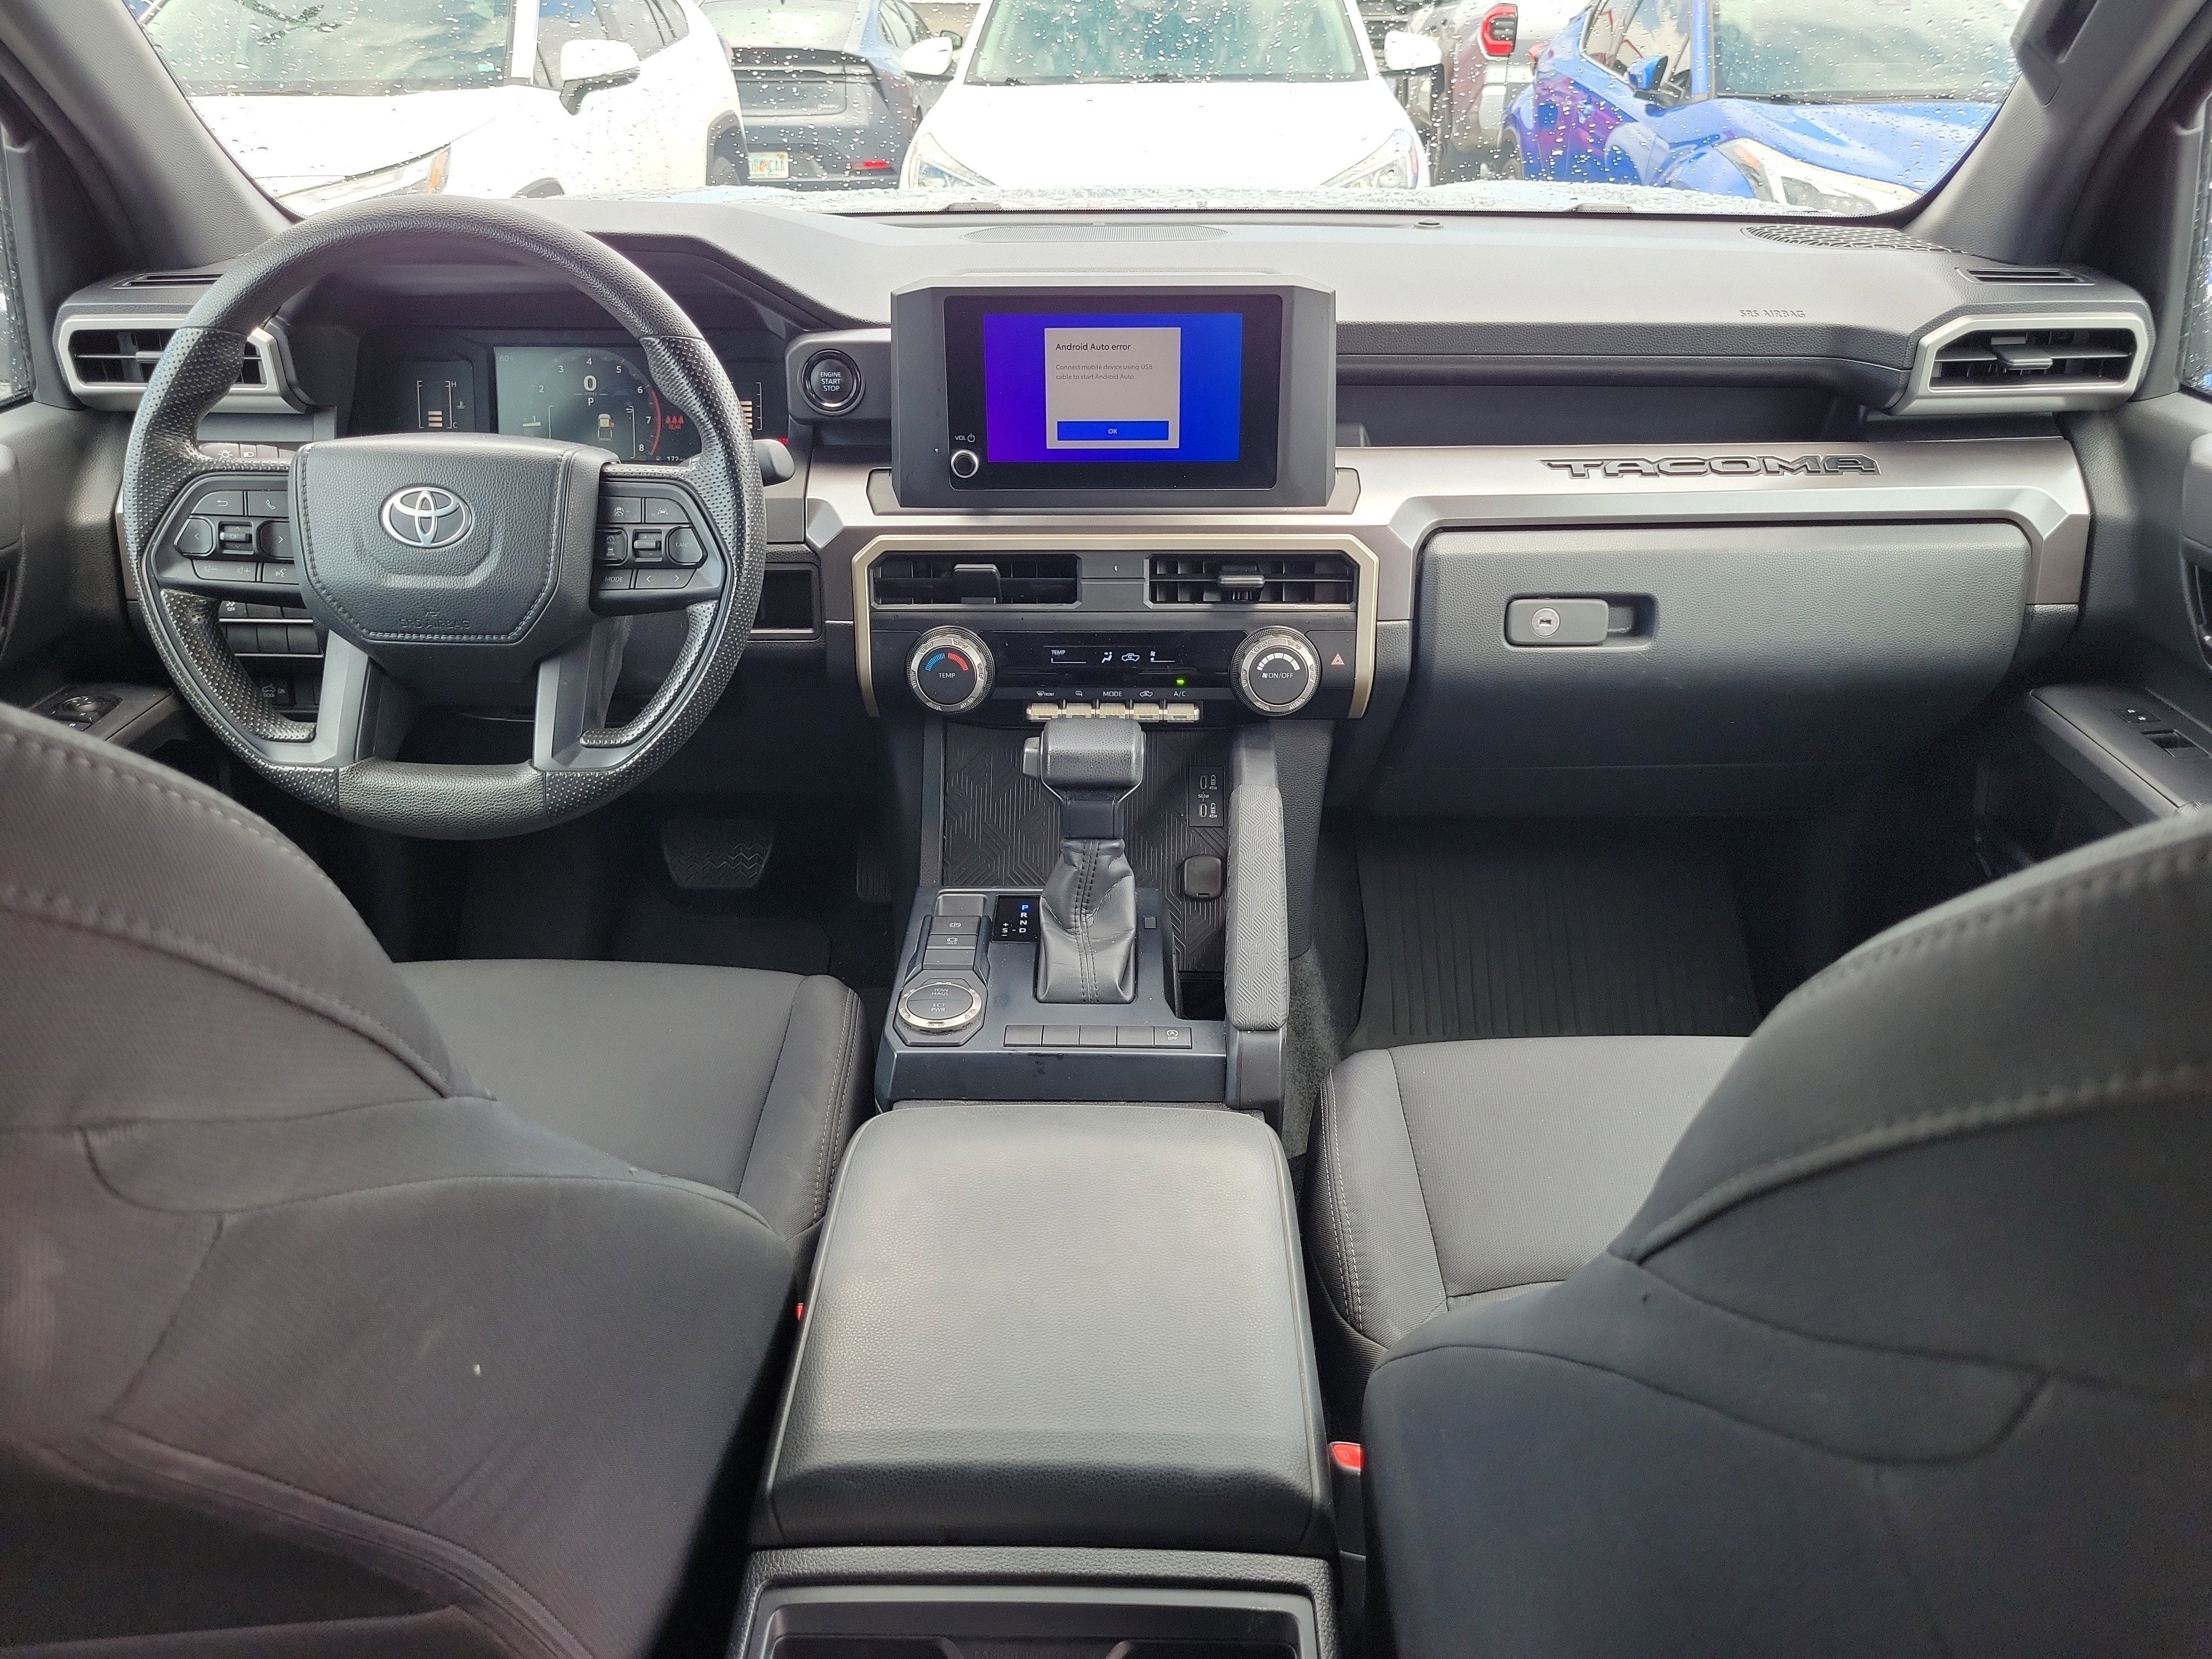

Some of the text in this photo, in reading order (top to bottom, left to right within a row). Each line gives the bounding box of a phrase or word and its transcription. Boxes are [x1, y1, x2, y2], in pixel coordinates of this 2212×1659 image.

[1763, 309, 1806, 318] AIRBAG
[586, 357, 592, 365] 4
[558, 365, 564, 373] 3
[616, 365, 622, 374] 5
[583, 375, 597, 391] 0
[637, 386, 644, 394] 6
[588, 397, 594, 406] P
[646, 416, 652, 424] 7
[639, 444, 645, 452] 8
[1537, 454, 1881, 479] TACOMA
